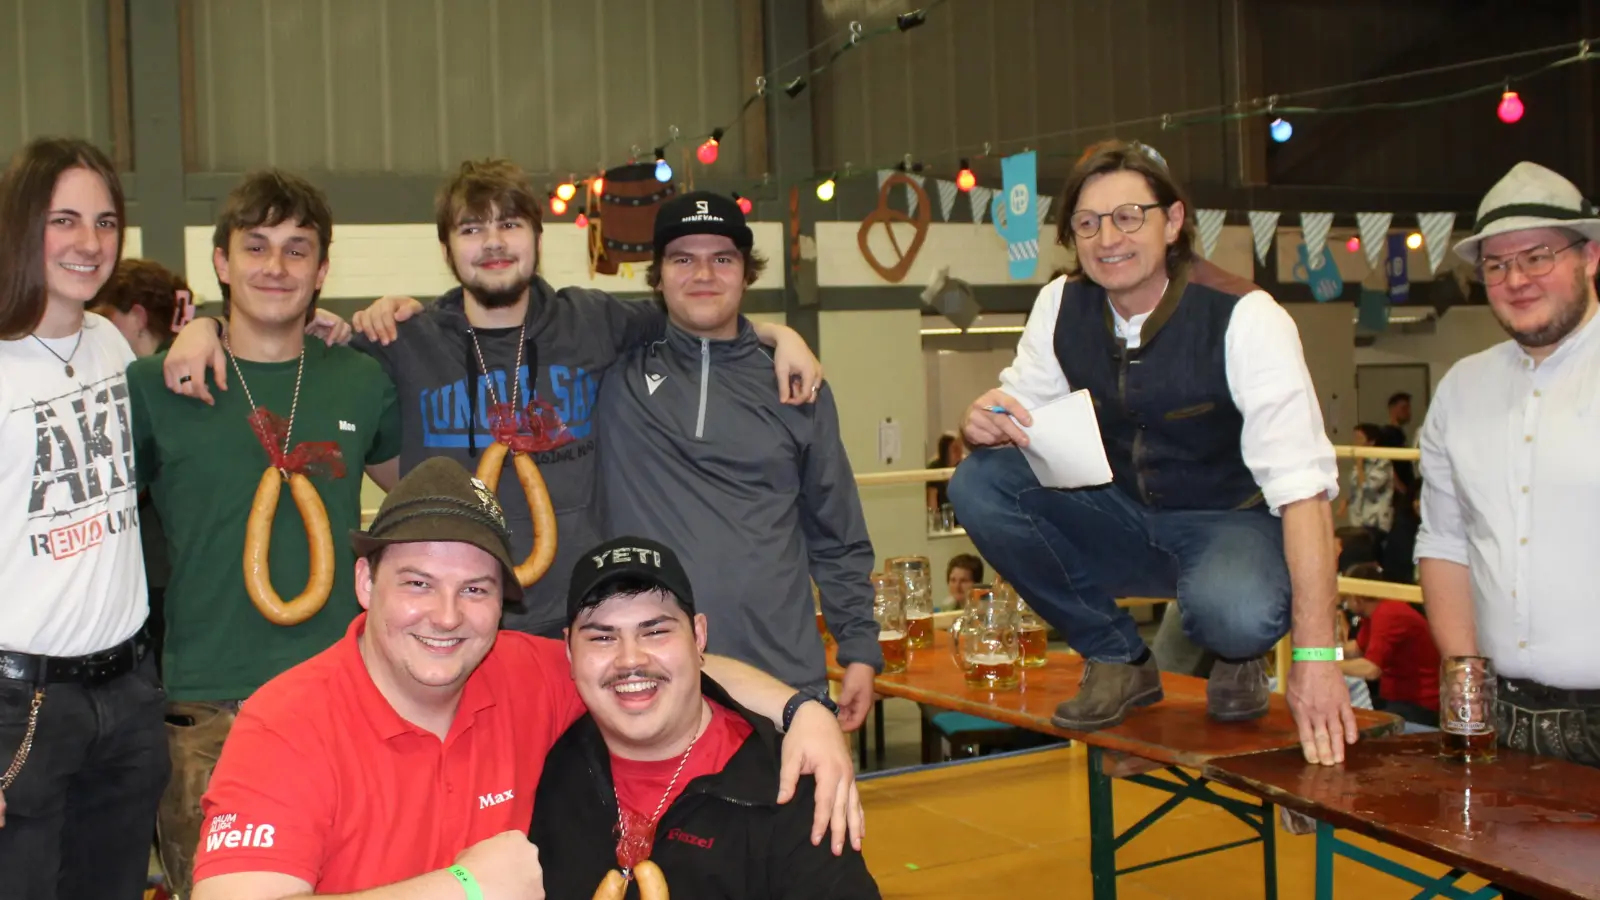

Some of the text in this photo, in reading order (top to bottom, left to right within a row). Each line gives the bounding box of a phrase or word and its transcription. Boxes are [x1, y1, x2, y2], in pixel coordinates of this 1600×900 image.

[592, 547, 661, 569] YETI
[478, 789, 514, 810] Max
[206, 823, 275, 853] weiß
